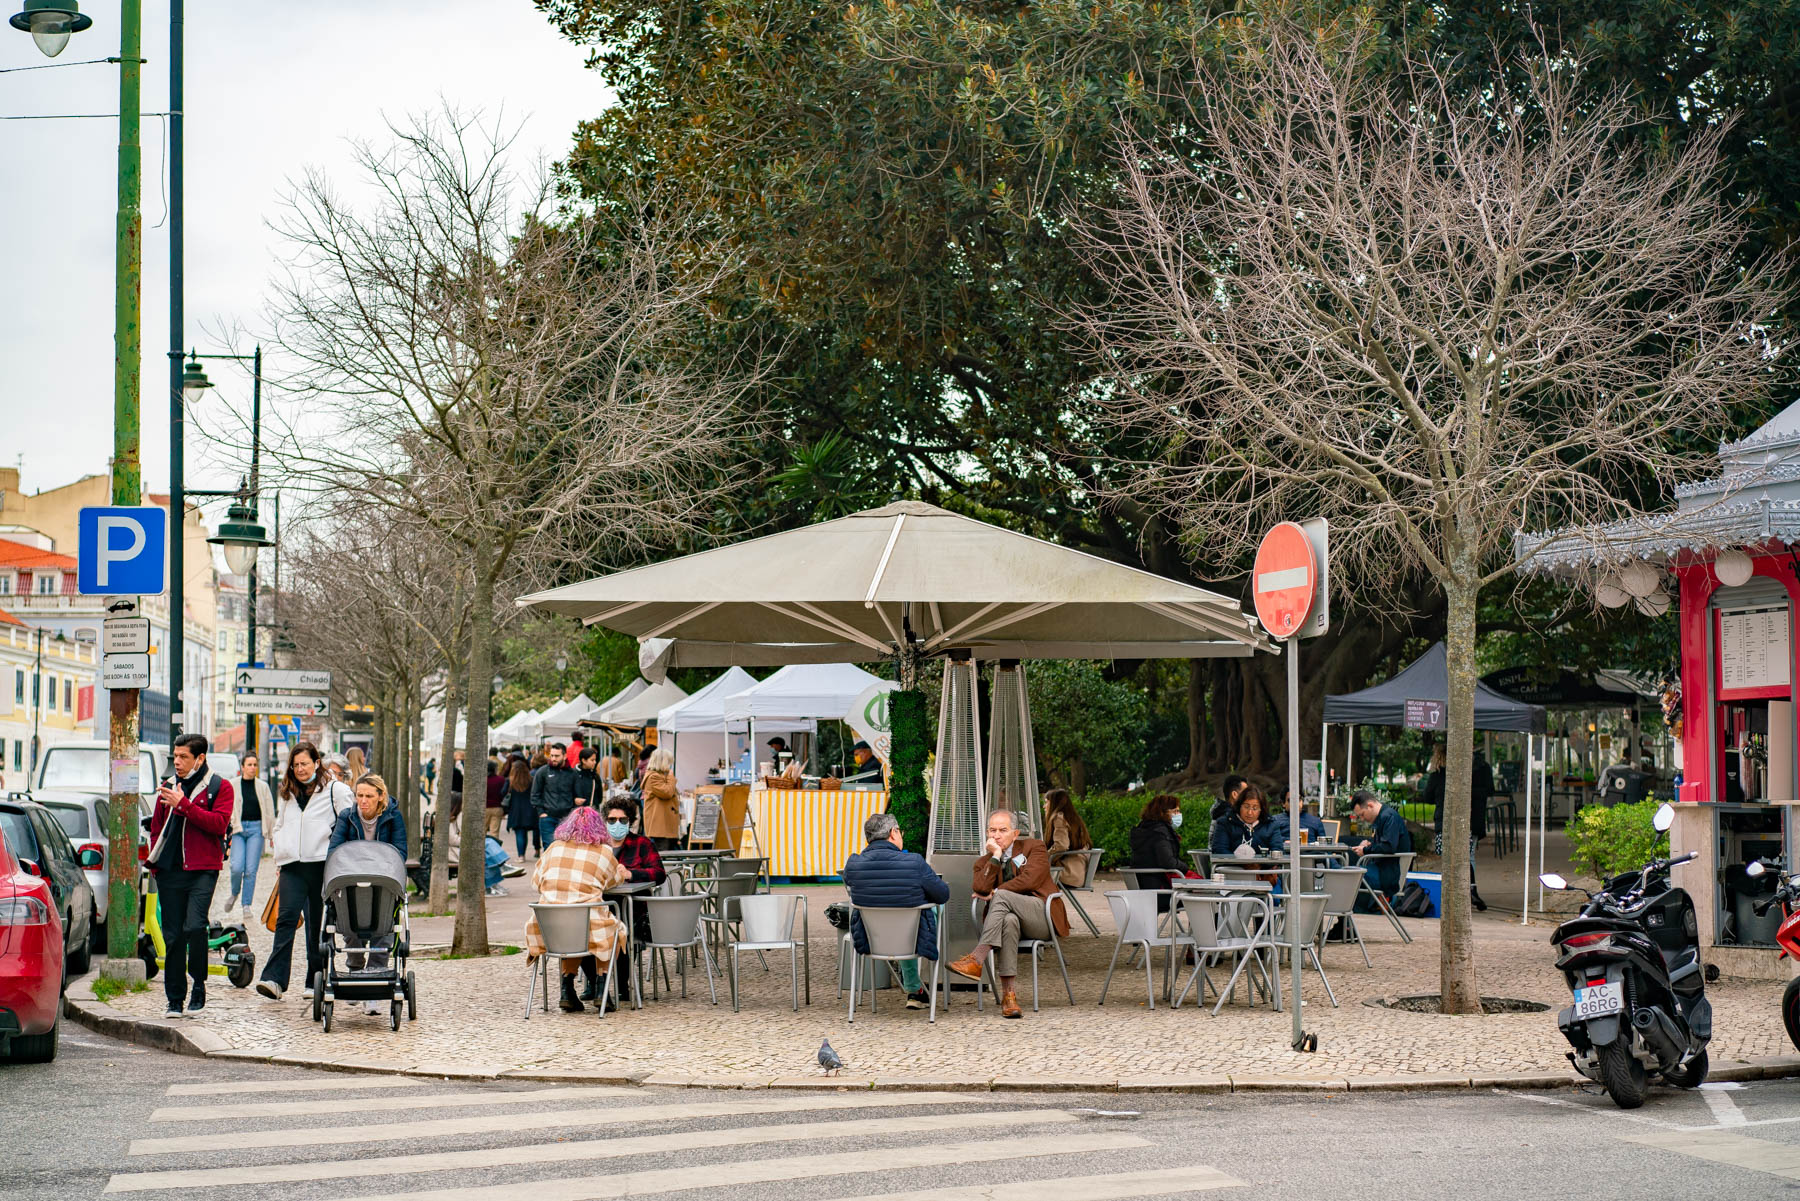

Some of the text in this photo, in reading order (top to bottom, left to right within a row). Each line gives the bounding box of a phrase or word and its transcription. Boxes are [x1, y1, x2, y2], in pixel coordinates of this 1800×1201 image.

[97, 516, 146, 587] P
[299, 675, 329, 684] Chiado
[236, 700, 273, 709] Reservatório
[275, 701, 282, 709] da
[1580, 997, 1618, 1014] 86RG
